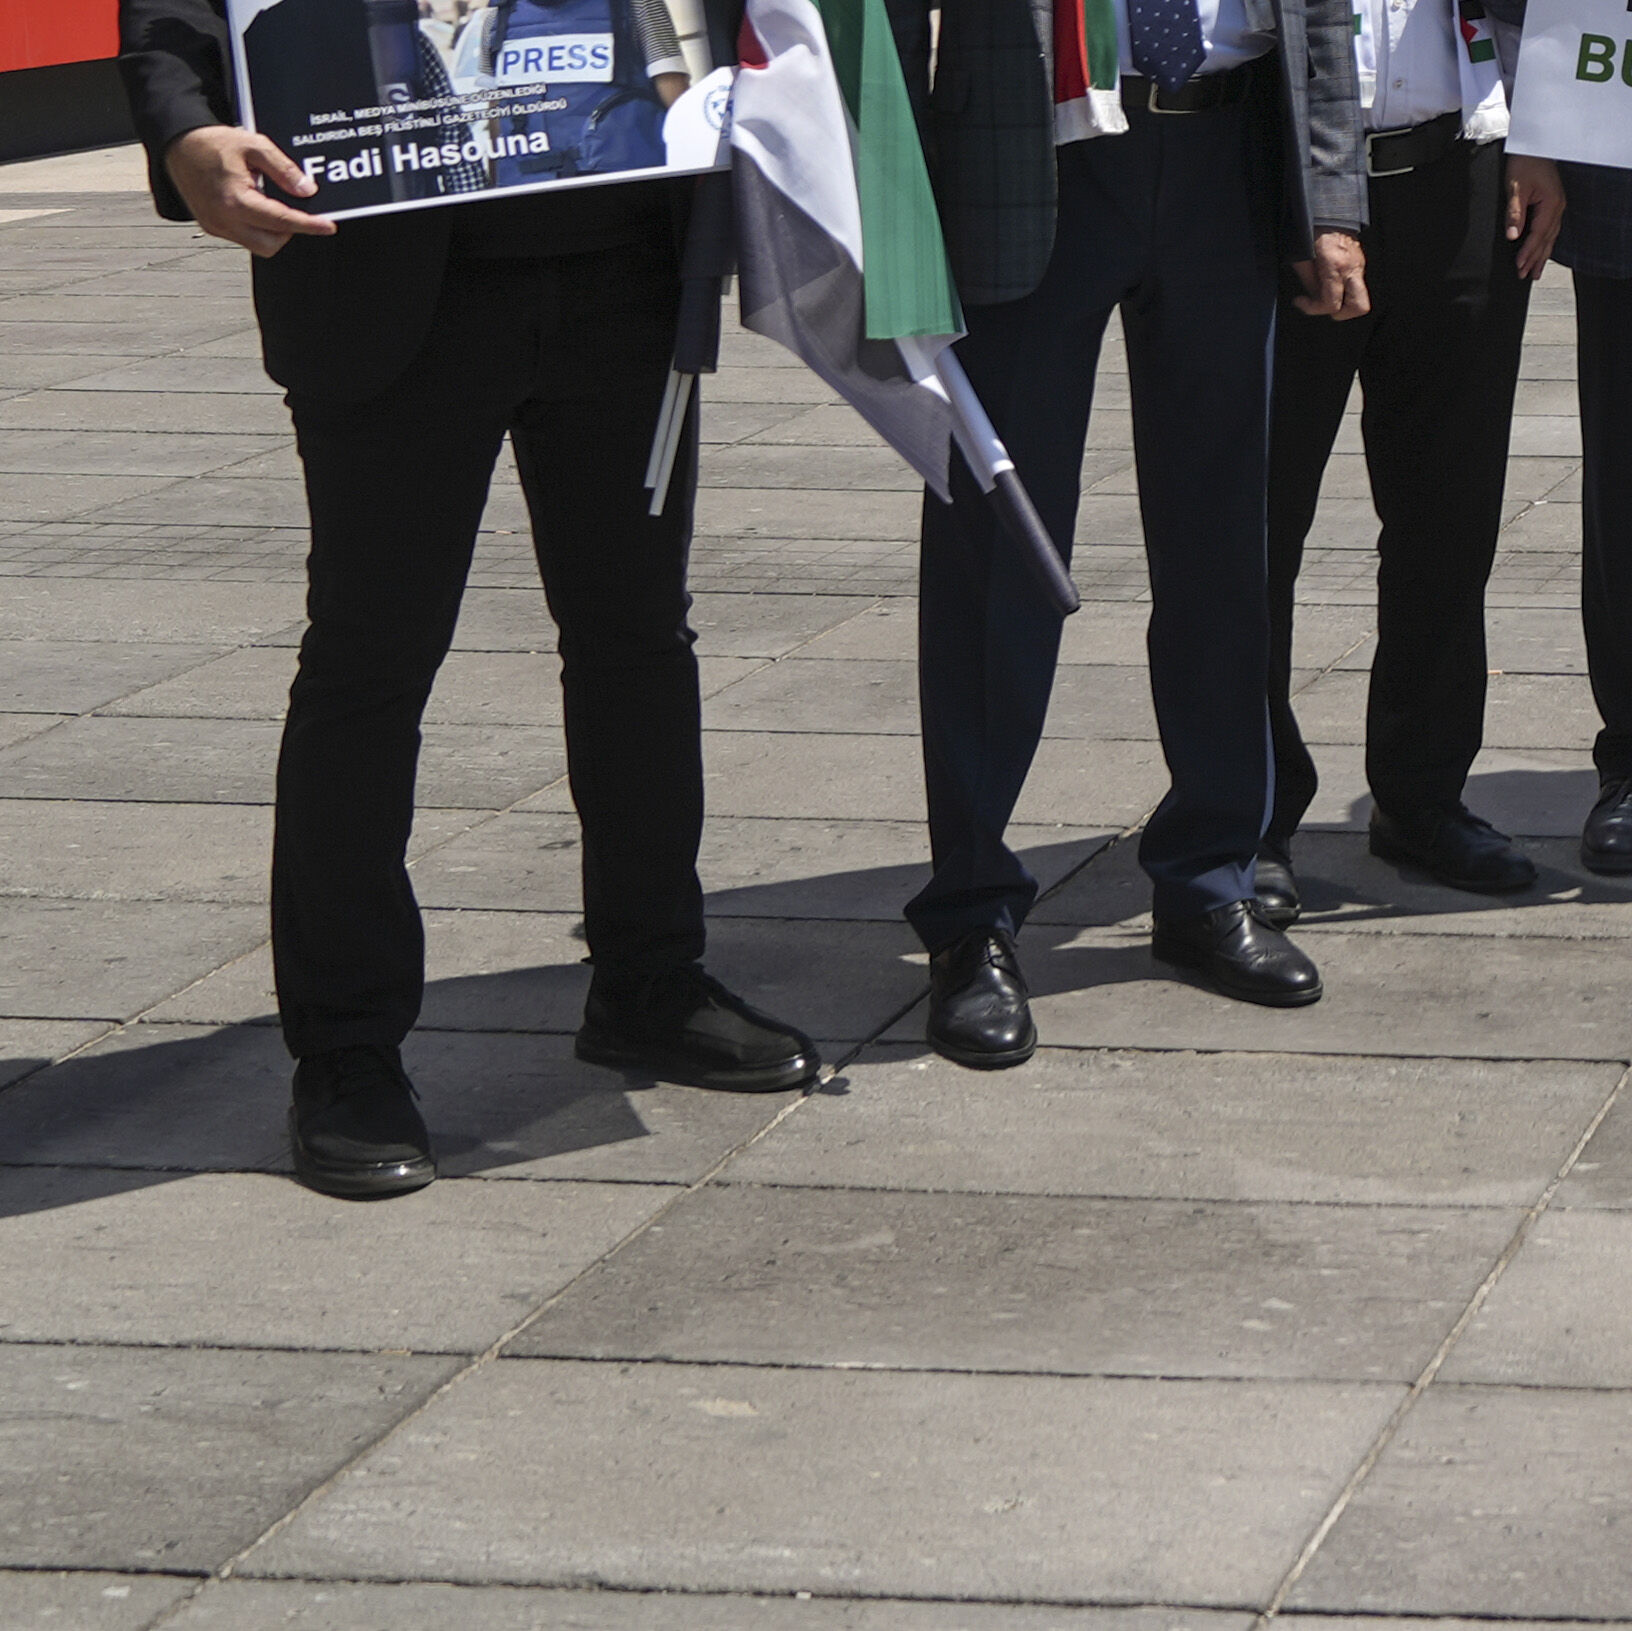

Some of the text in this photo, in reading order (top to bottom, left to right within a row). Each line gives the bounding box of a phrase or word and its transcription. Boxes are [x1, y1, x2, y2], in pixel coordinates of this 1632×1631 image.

[503, 43, 610, 75] PRESS
[310, 108, 353, 126] İSRAİL,
[354, 105, 396, 122] MEDYA
[292, 128, 358, 147] SALDIRIDA
[358, 124, 384, 139] BEŞ
[303, 130, 551, 184] Fadi Hasouna
